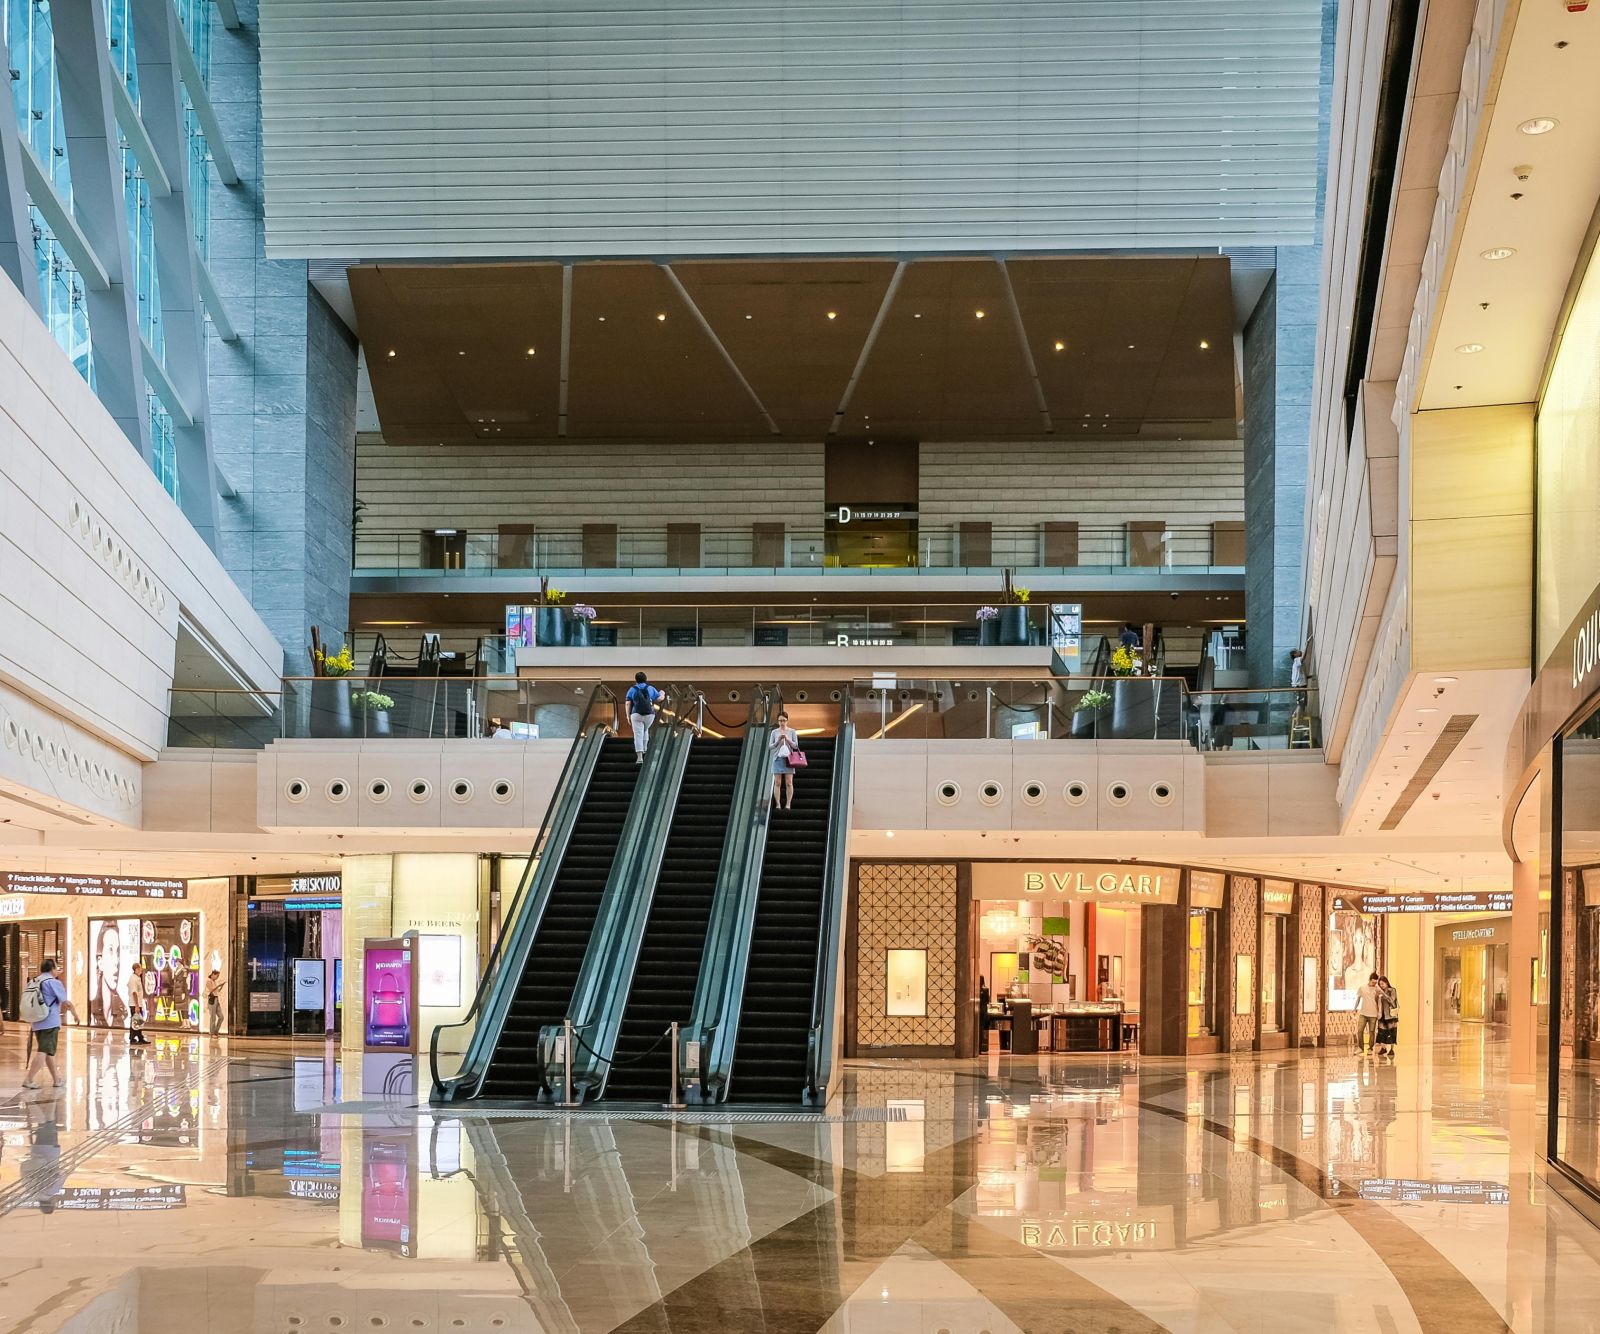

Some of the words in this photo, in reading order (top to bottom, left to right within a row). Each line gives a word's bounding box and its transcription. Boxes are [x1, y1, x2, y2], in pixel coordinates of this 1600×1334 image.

[838, 506, 850, 524] D
[837, 634, 849, 647] R
[1024, 872, 1162, 896] BVLGARI
